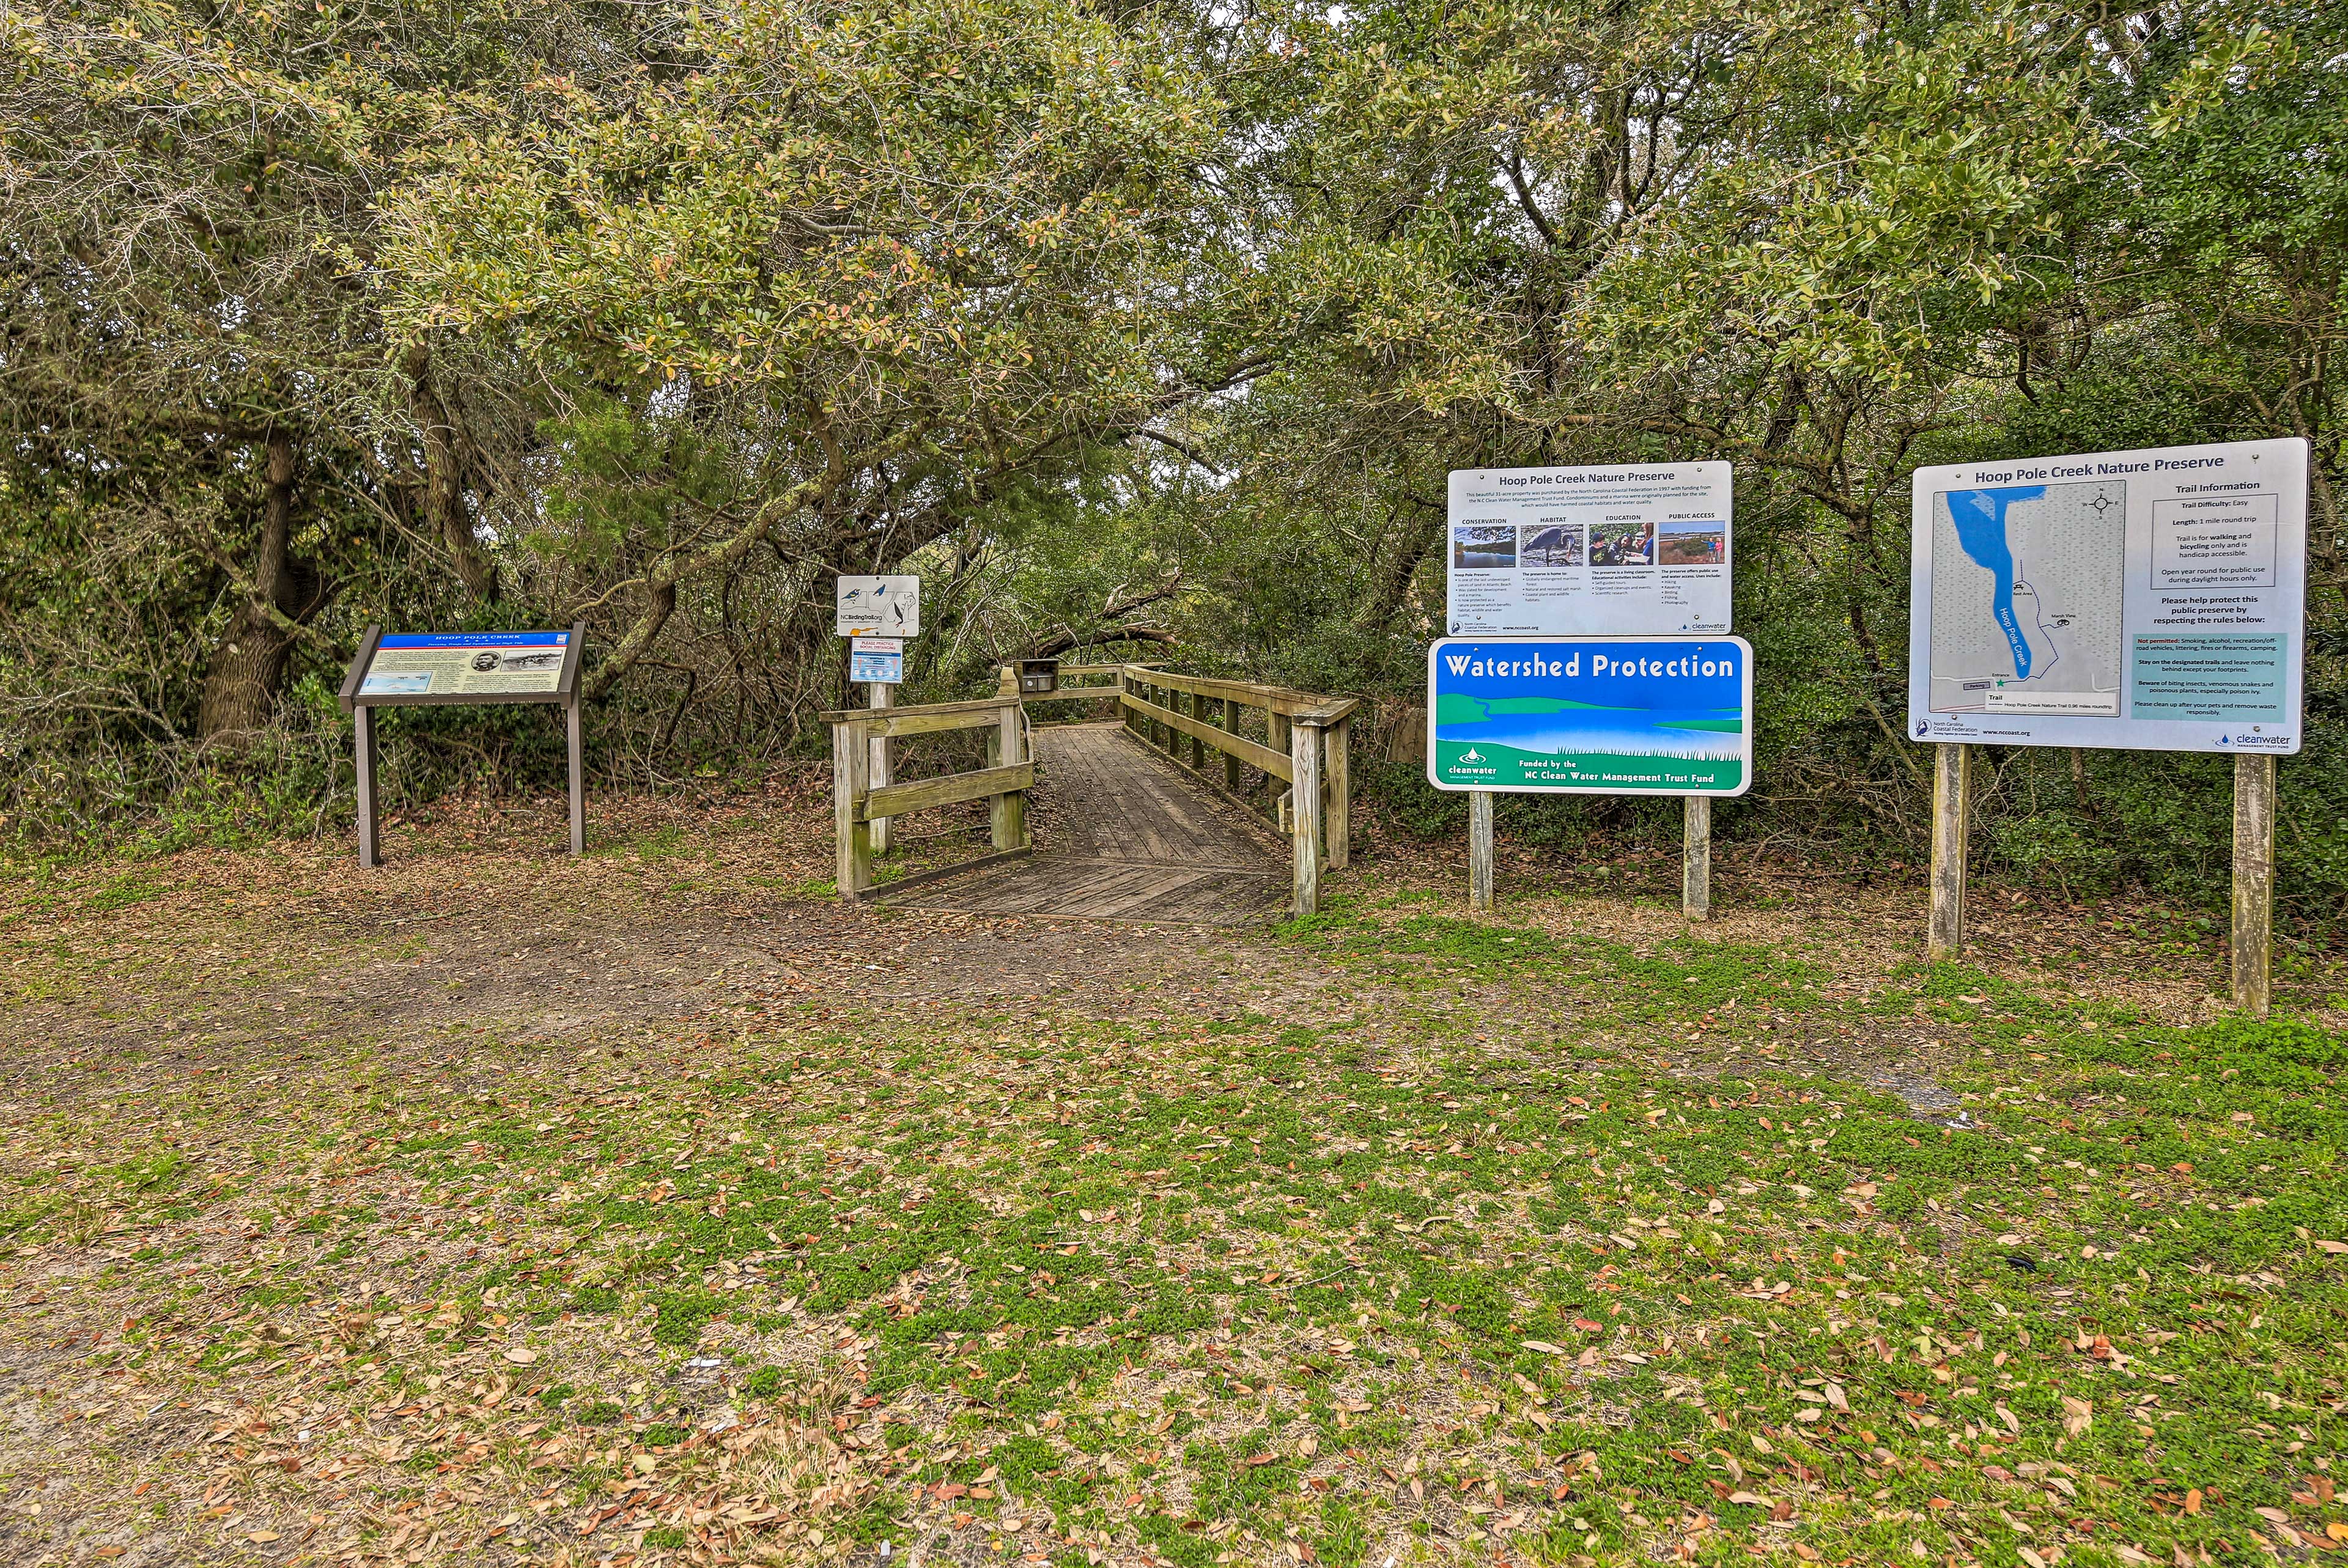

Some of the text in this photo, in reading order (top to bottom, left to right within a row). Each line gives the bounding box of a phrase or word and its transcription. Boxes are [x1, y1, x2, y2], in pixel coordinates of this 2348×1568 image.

[1975, 457, 2224, 485] Hoop Pole Creek Nature Preserve
[1499, 471, 1675, 488] Hoop Pole Creek Nature Preserve
[2176, 481, 2260, 493] Trail Information
[2198, 500, 2231, 509] Difficulty:
[2173, 518, 2198, 527] Length:
[2209, 533, 2237, 542] walking
[2179, 542, 2209, 551] bicycling
[2189, 597, 2207, 605] help
[2209, 596, 2240, 605] protect
[2171, 606, 2196, 615] public
[2236, 606, 2247, 615] by
[2154, 616, 2195, 625] respecting
[1999, 608, 2027, 666] Hoop Pole Creek
[1444, 652, 1733, 677] Watershed Protection
[2237, 734, 2291, 745] cleanwater
[1551, 760, 1560, 769] by
[1448, 765, 1497, 774] cleanwater
[1570, 772, 1598, 781] Water
[1603, 773, 1661, 783] Management
[1665, 774, 1688, 782] Trust
[1691, 774, 1714, 783] Fund
